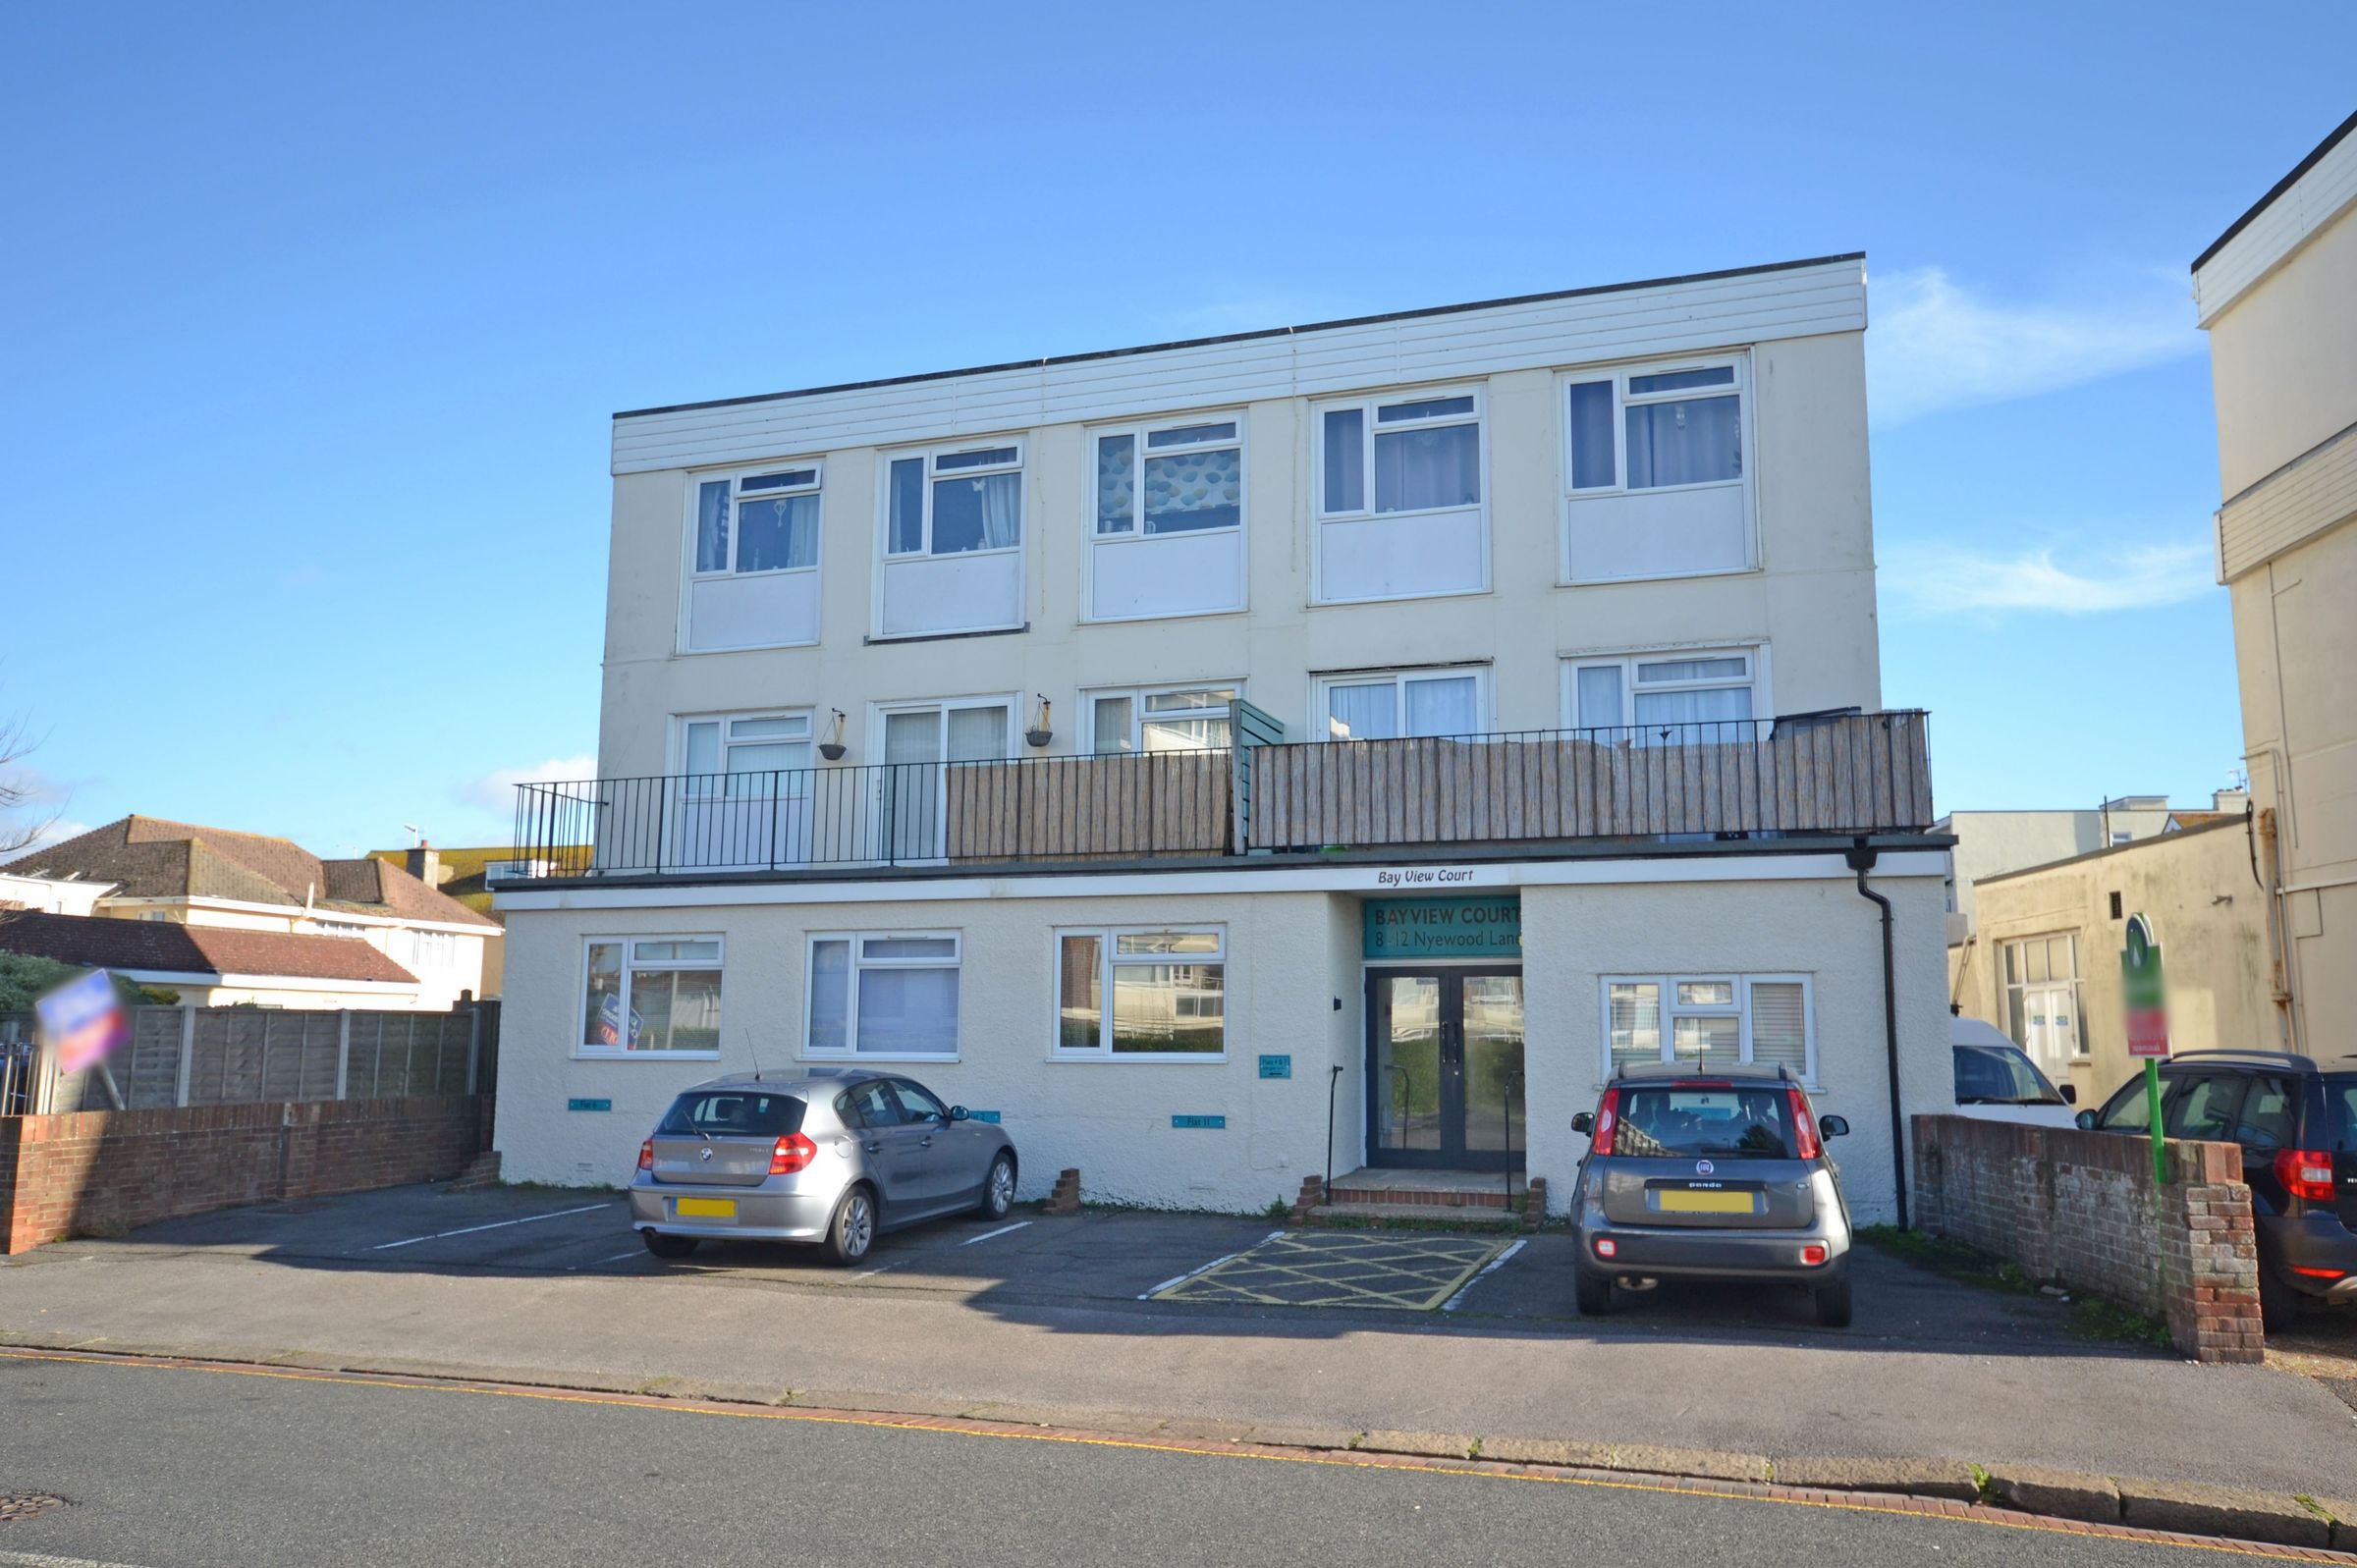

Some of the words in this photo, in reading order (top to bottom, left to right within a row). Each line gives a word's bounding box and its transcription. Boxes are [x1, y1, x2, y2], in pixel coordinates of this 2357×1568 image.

[1378, 871, 1401, 888] Bay
[1404, 870, 1434, 883] View
[1438, 869, 1474, 882] Court
[1375, 908, 1454, 925] BAYVIEW
[1461, 906, 1521, 924] COURT
[1375, 931, 1384, 947] 8
[1396, 930, 1408, 947] 12
[1414, 929, 1484, 951] Nyewood
